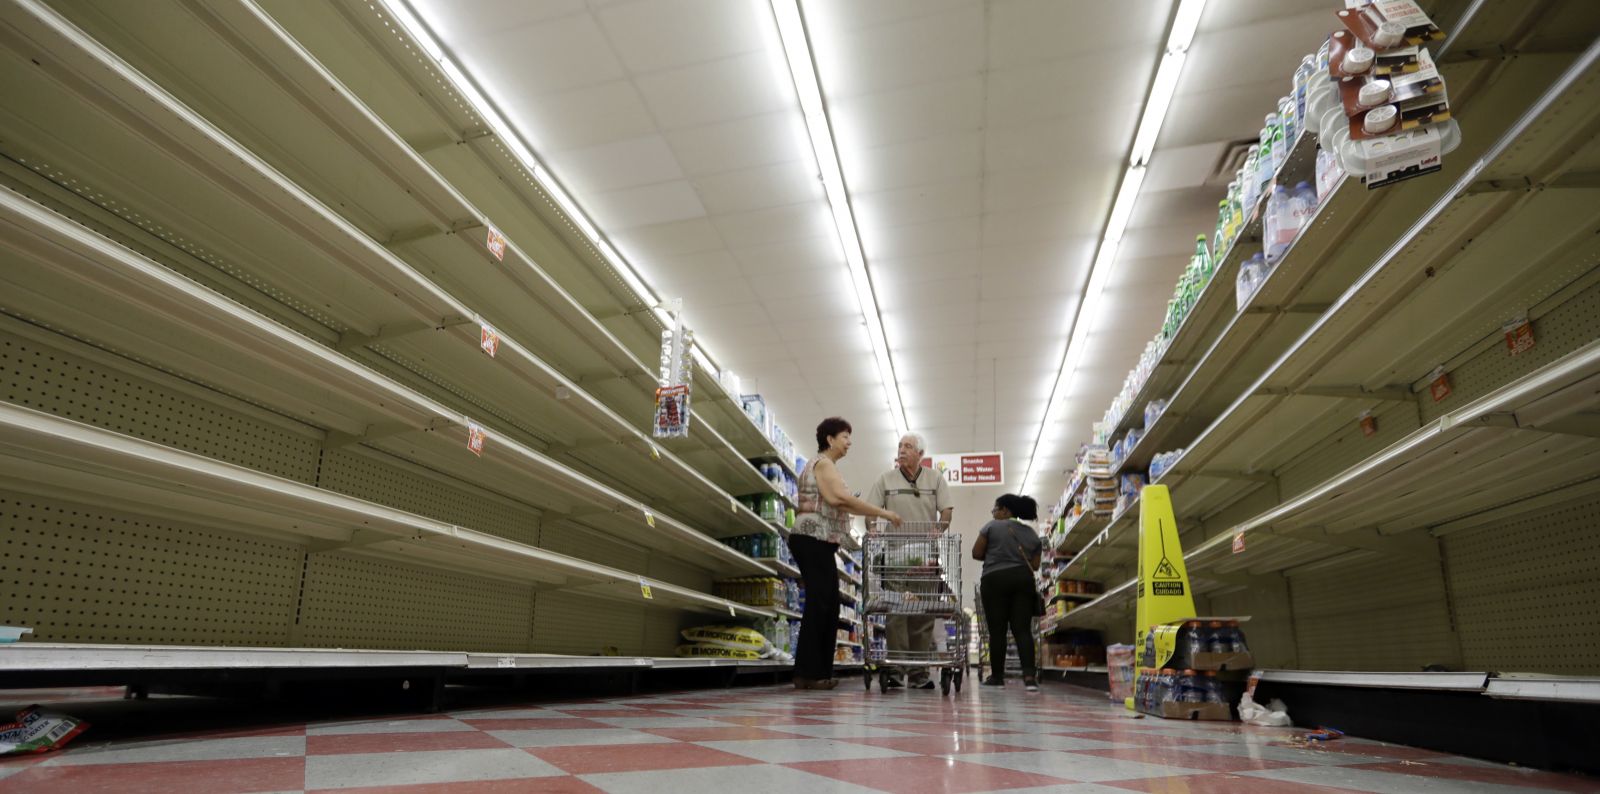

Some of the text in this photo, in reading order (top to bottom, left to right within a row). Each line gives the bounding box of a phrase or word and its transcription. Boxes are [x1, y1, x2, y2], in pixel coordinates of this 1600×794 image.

[947, 470, 959, 481] 13
[704, 631, 737, 641] MORTON
[700, 648, 731, 656] MORTON
[29, 720, 50, 736] WATER
